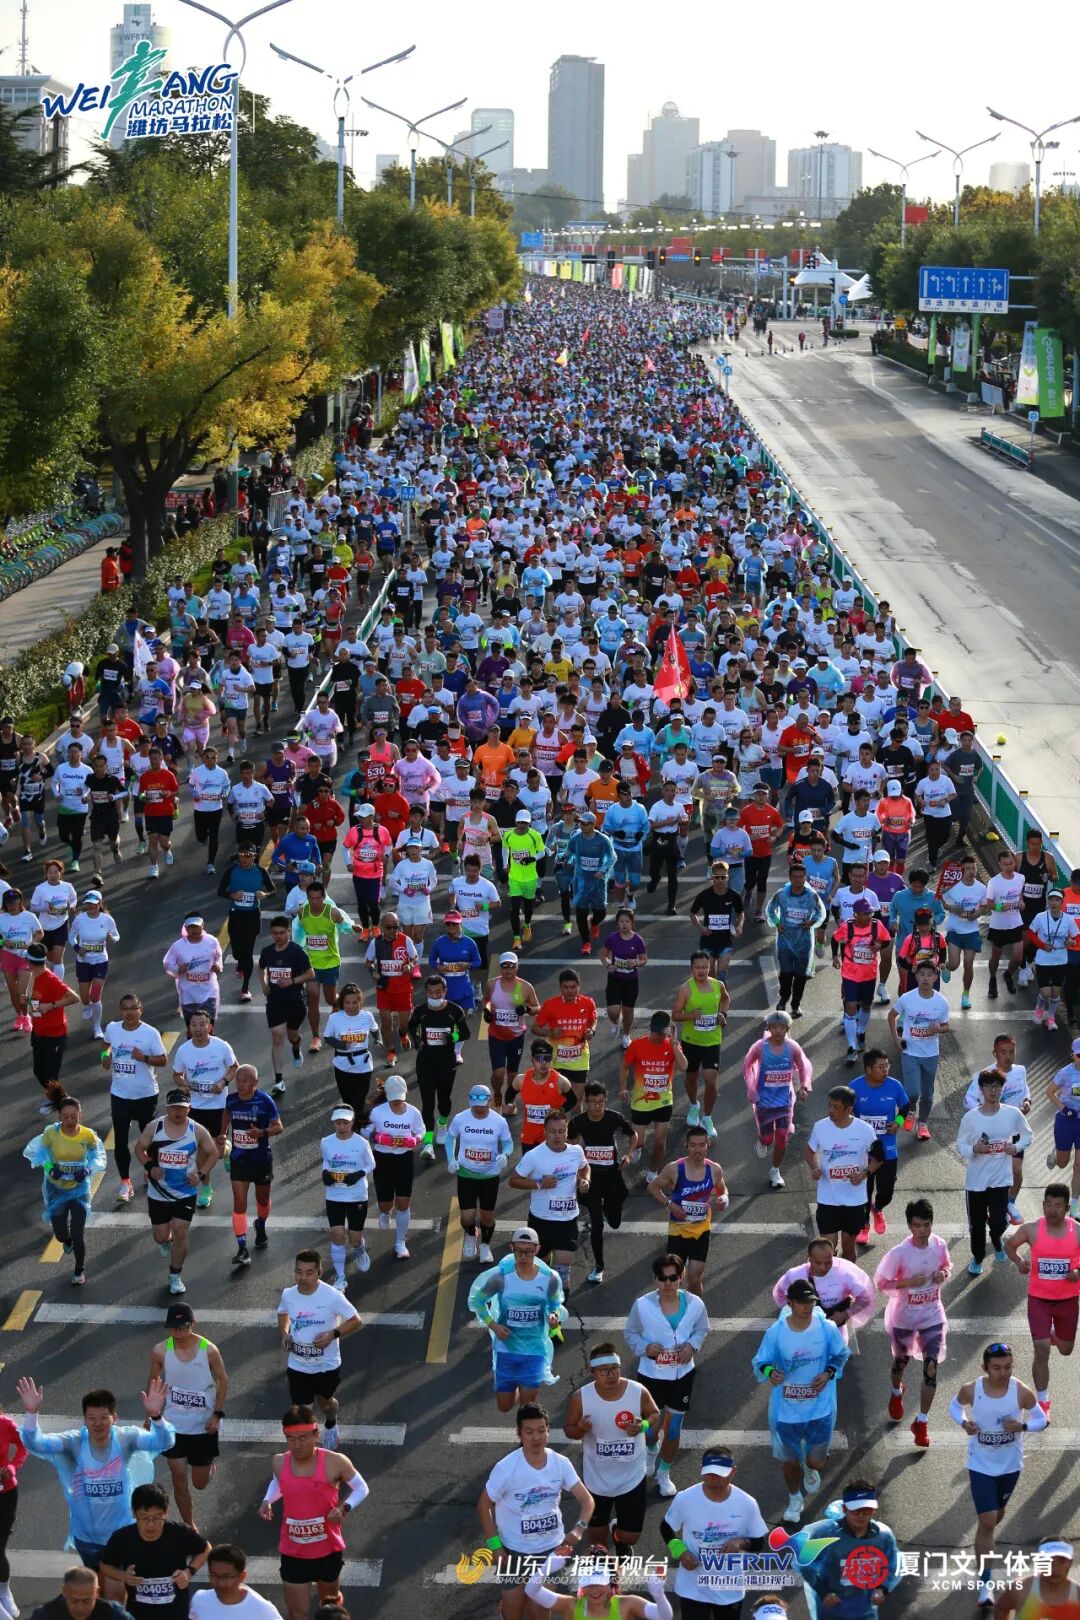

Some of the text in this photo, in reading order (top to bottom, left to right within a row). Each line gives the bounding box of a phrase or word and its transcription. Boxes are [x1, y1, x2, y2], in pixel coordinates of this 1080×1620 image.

[943, 870, 962, 881] 5:30
[383, 1120, 411, 1130] Goertek
[464, 1125, 495, 1135] Goertek
[1039, 1263, 1069, 1272] B04933
[508, 1310, 540, 1320] B03751
[172, 1391, 204, 1405] B04562
[598, 1443, 633, 1454] B04442
[85, 1482, 122, 1494] B03976
[522, 1515, 557, 1531] B04252
[288, 1523, 324, 1535] A01163
[136, 1582, 174, 1594] B04055
